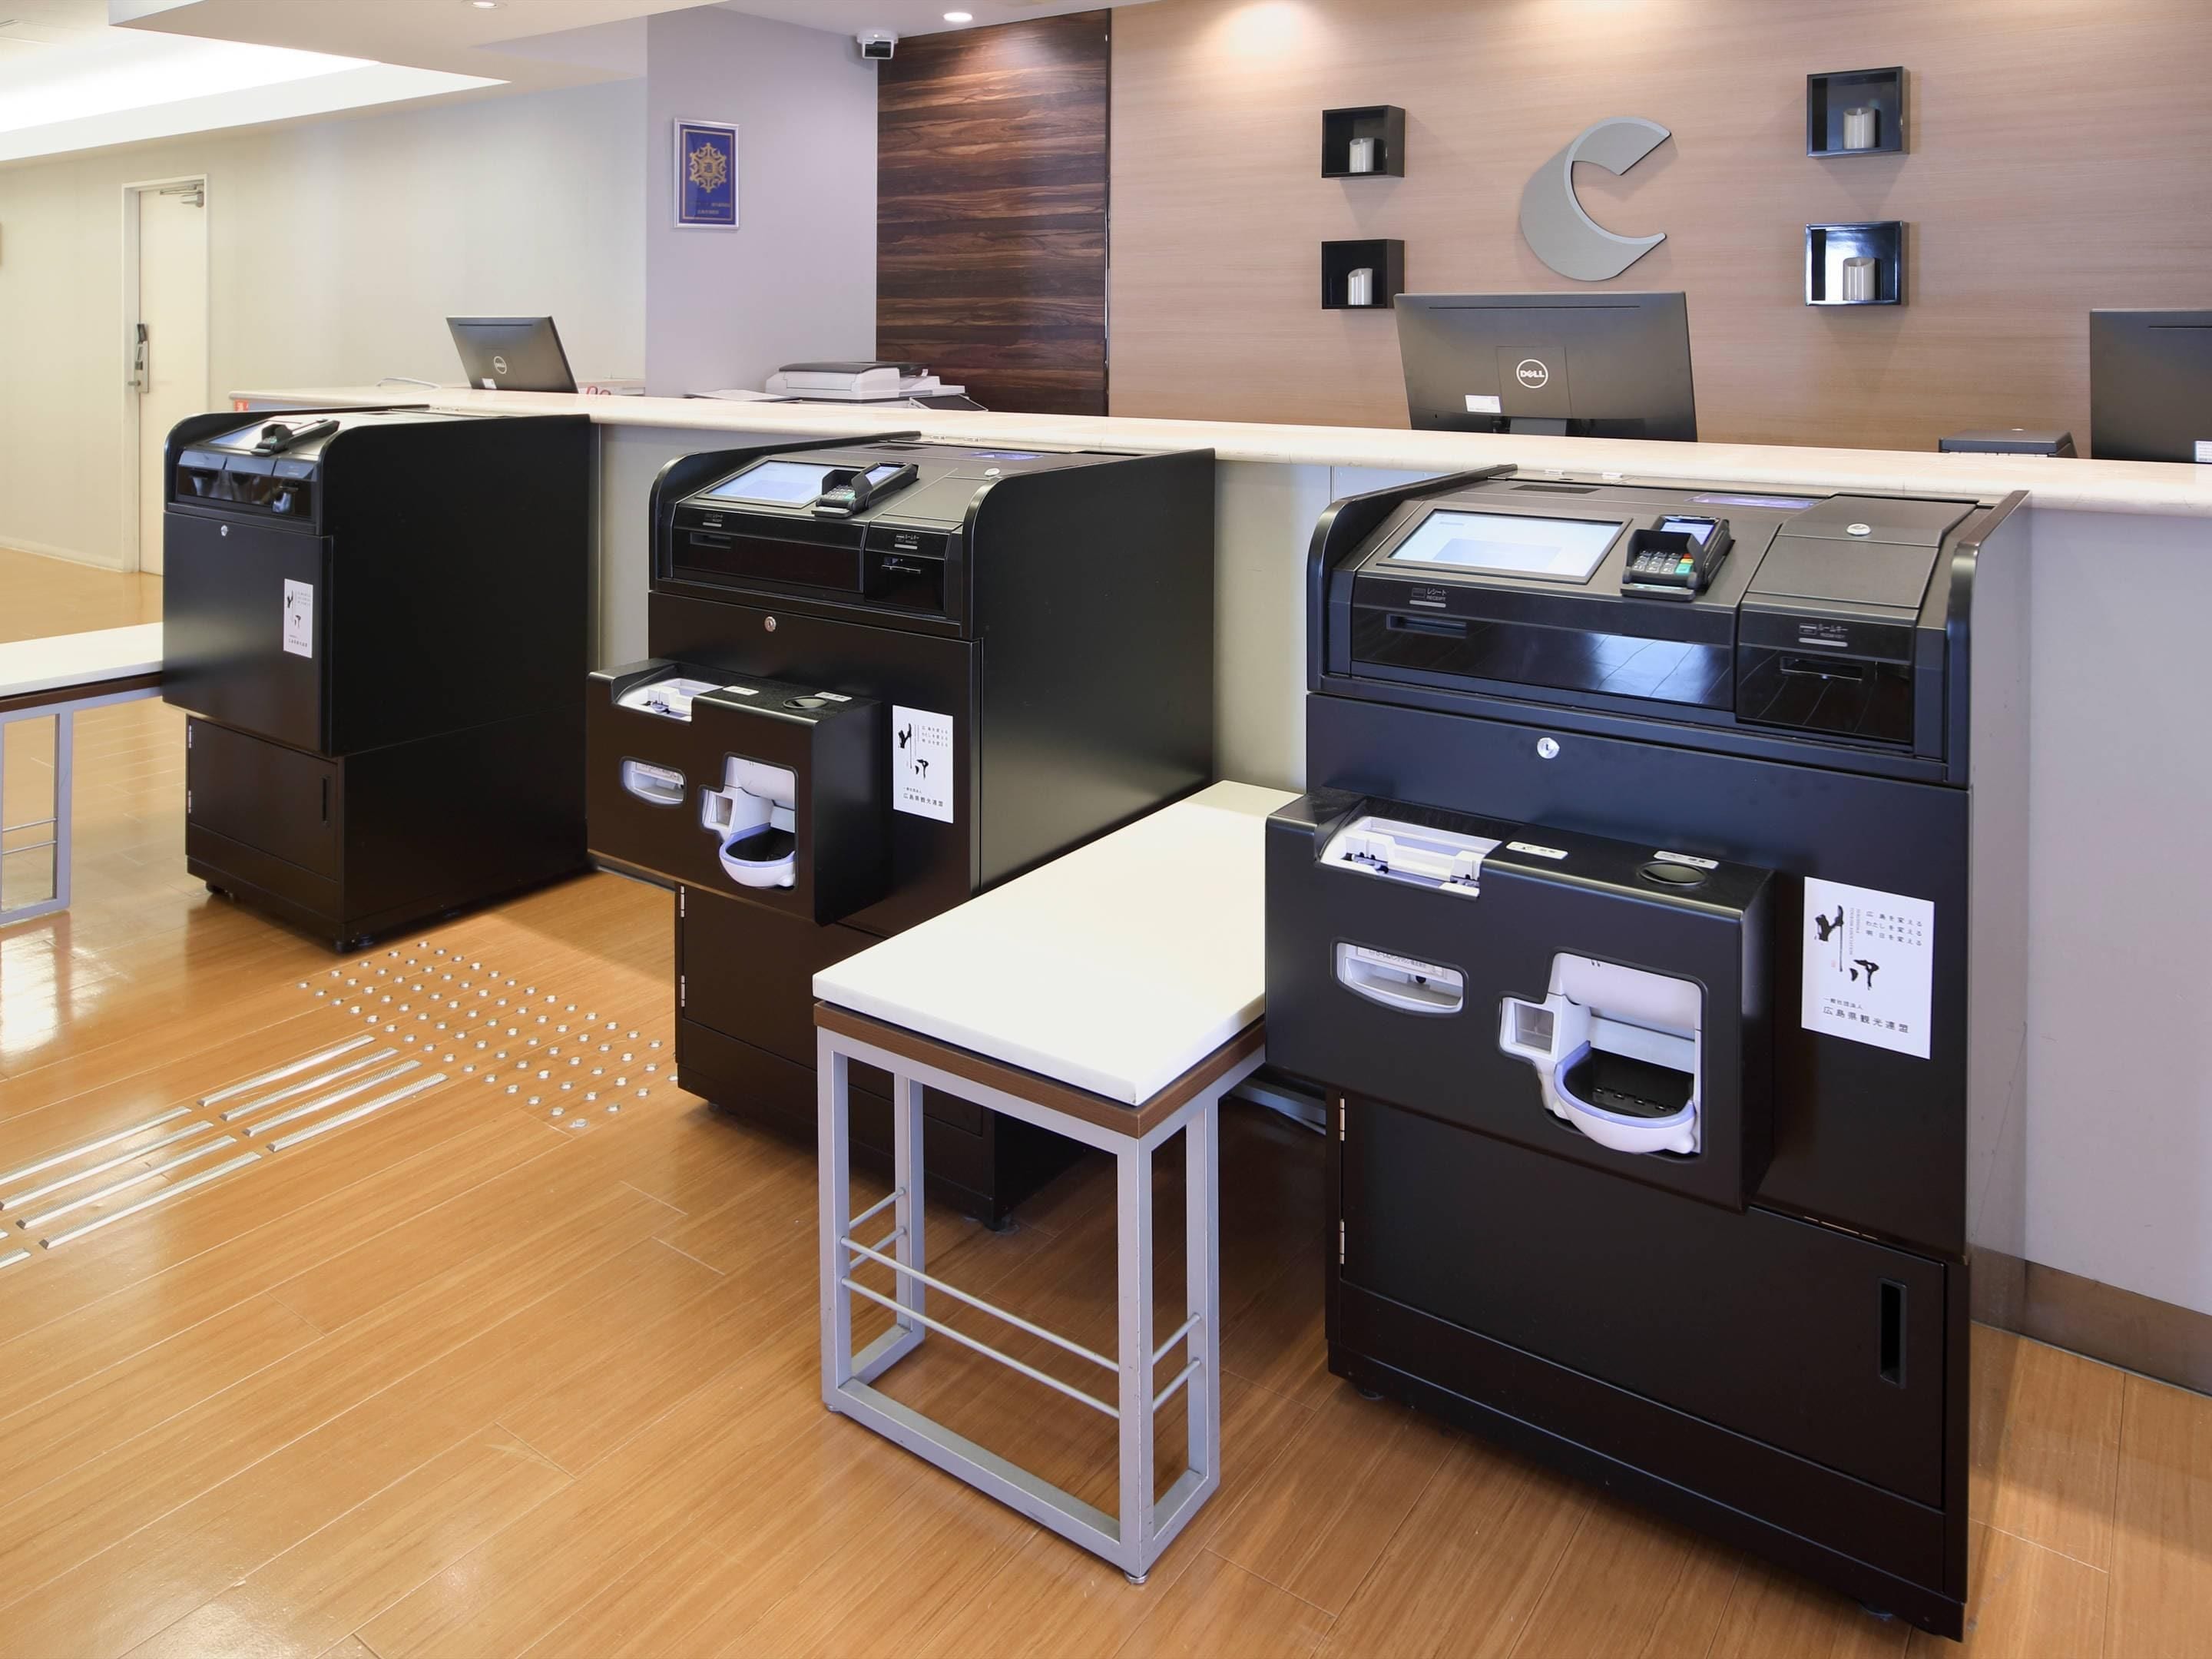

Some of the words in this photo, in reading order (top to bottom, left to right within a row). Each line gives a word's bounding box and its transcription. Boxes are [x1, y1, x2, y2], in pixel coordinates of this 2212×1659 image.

[1519, 369, 1545, 378] DELL
[1426, 588, 1447, 596] レシート
[1823, 1006, 1909, 1034] 広島県観光連盟
